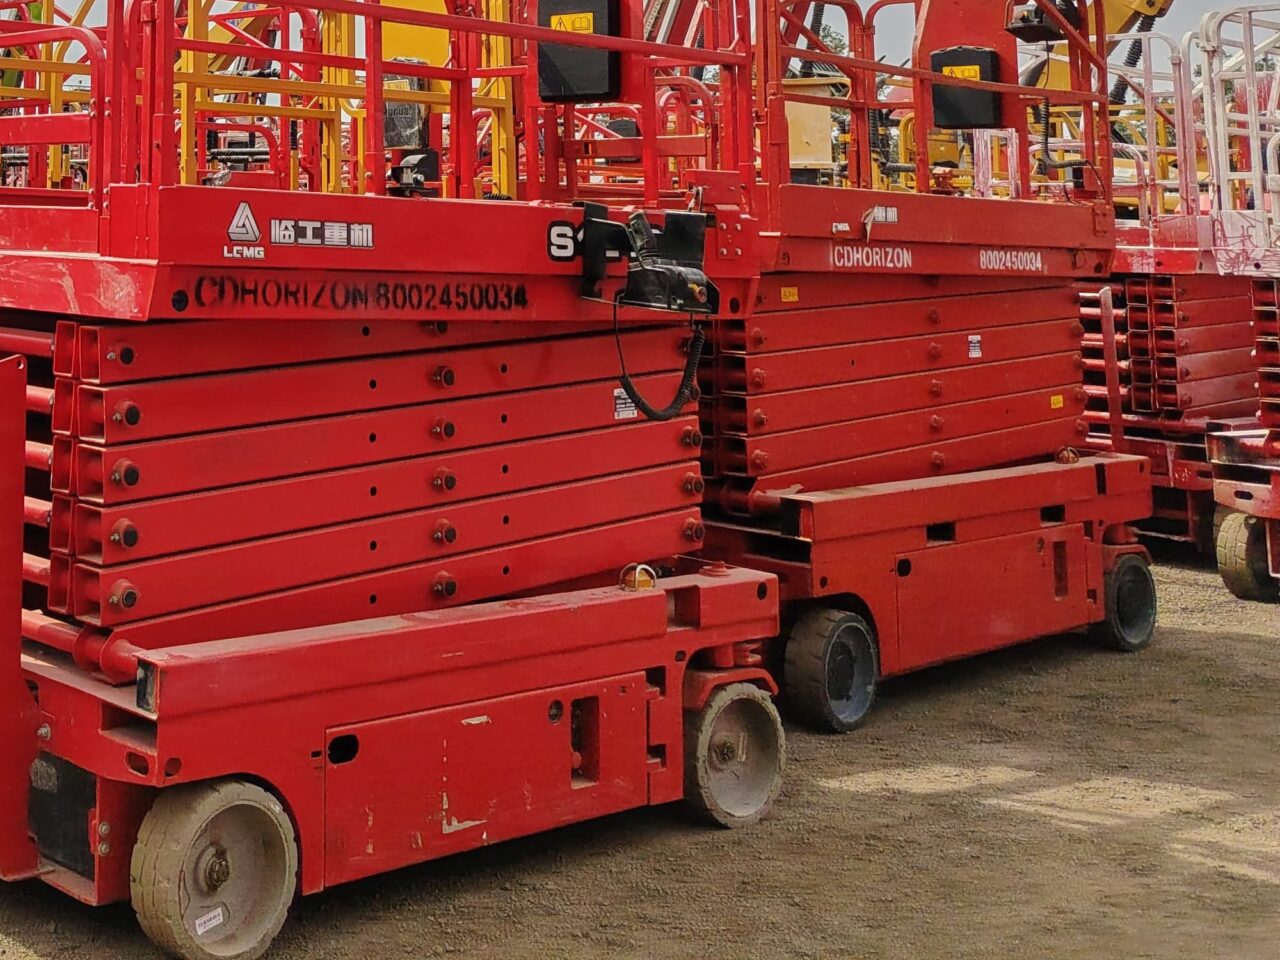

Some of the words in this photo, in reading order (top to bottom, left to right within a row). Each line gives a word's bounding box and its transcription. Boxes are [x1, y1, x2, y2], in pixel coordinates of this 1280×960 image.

[270, 219, 373, 247] 临工重机
[834, 245, 912, 268] CDHORIZON
[979, 249, 1042, 271] 8002450034
[375, 280, 529, 312] 8002450034
